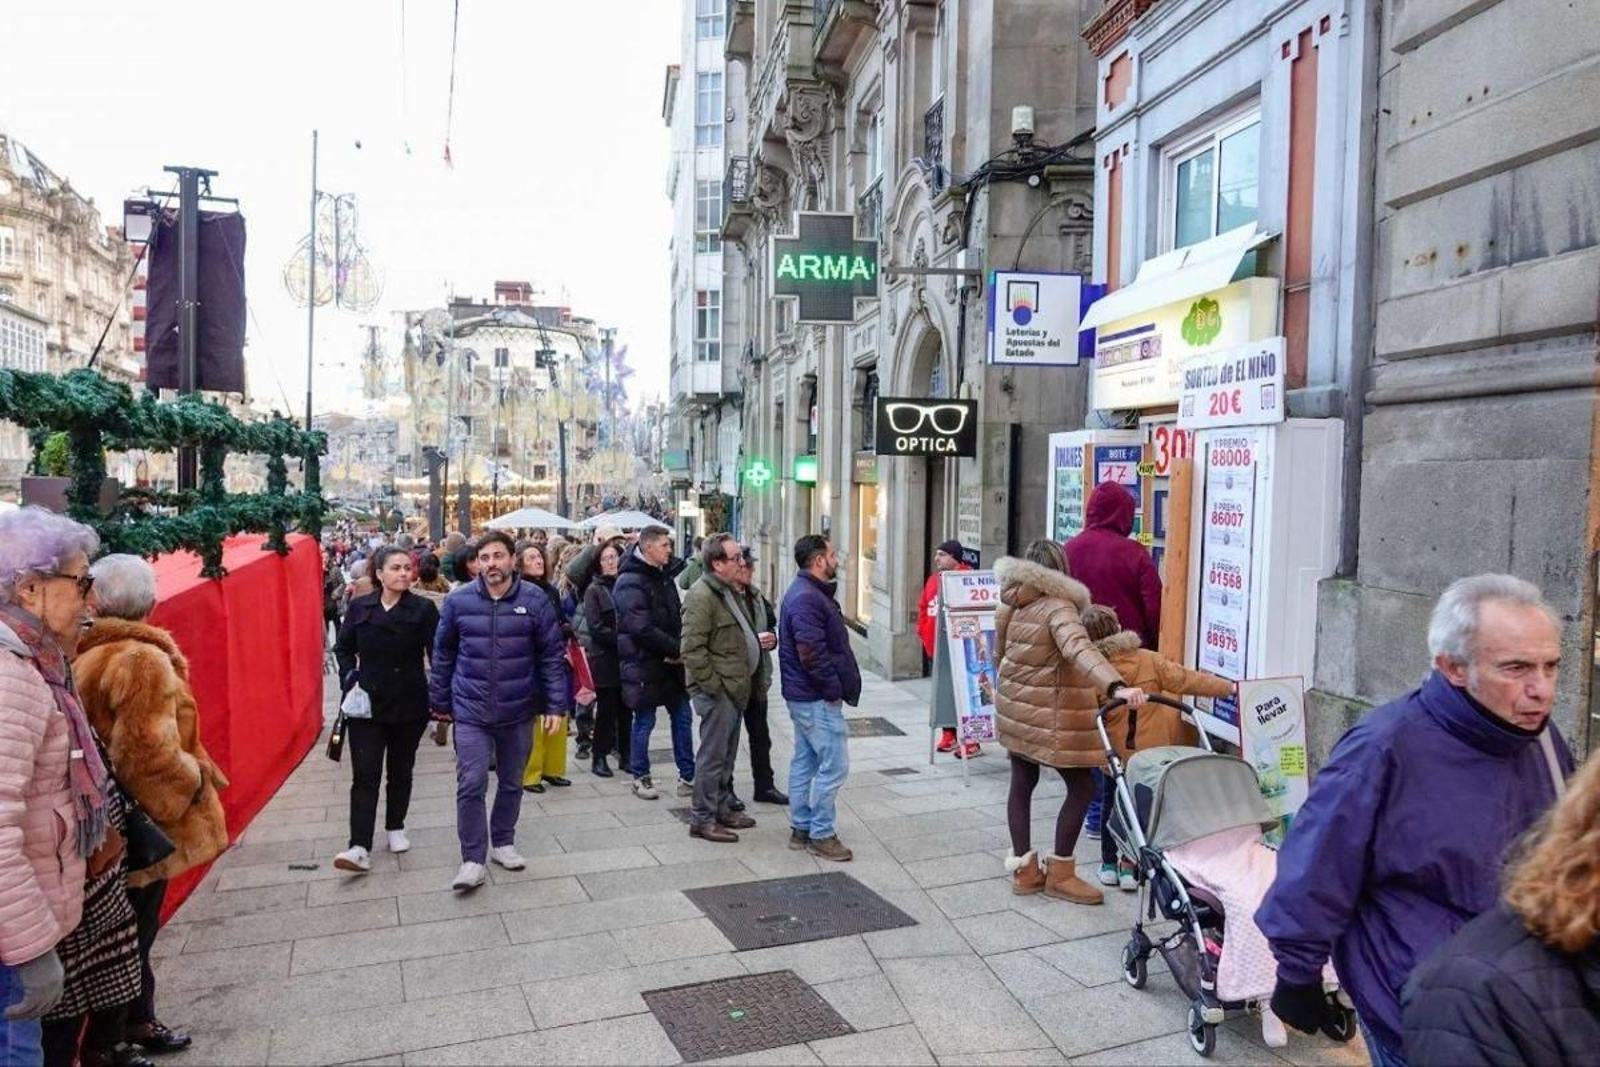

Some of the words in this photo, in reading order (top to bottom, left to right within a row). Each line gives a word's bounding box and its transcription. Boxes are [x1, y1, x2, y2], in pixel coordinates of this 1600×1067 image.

[777, 254, 875, 281] ARMA
[1042, 330, 1048, 339] y
[1006, 338, 1045, 350] Apuestas
[1047, 339, 1060, 348] del
[1006, 348, 1035, 358] Estado
[1184, 364, 1218, 390] SORTEO
[1220, 362, 1233, 384] de
[1235, 359, 1246, 382] EL
[1248, 350, 1276, 379] NIÑO
[1219, 437, 1248, 449] PREMIO
[1211, 448, 1251, 467] 88008
[1219, 502, 1242, 513] PREMIO
[1211, 511, 1244, 528] 86007
[1217, 562, 1241, 574] PREMIO
[963, 577, 974, 586] EL
[1209, 570, 1242, 590] 01568
[970, 588, 989, 601] 20
[1213, 623, 1236, 638] PREMIO
[1206, 630, 1238, 653] 88979
[1255, 695, 1281, 715] Para
[1257, 703, 1288, 726] llevar
